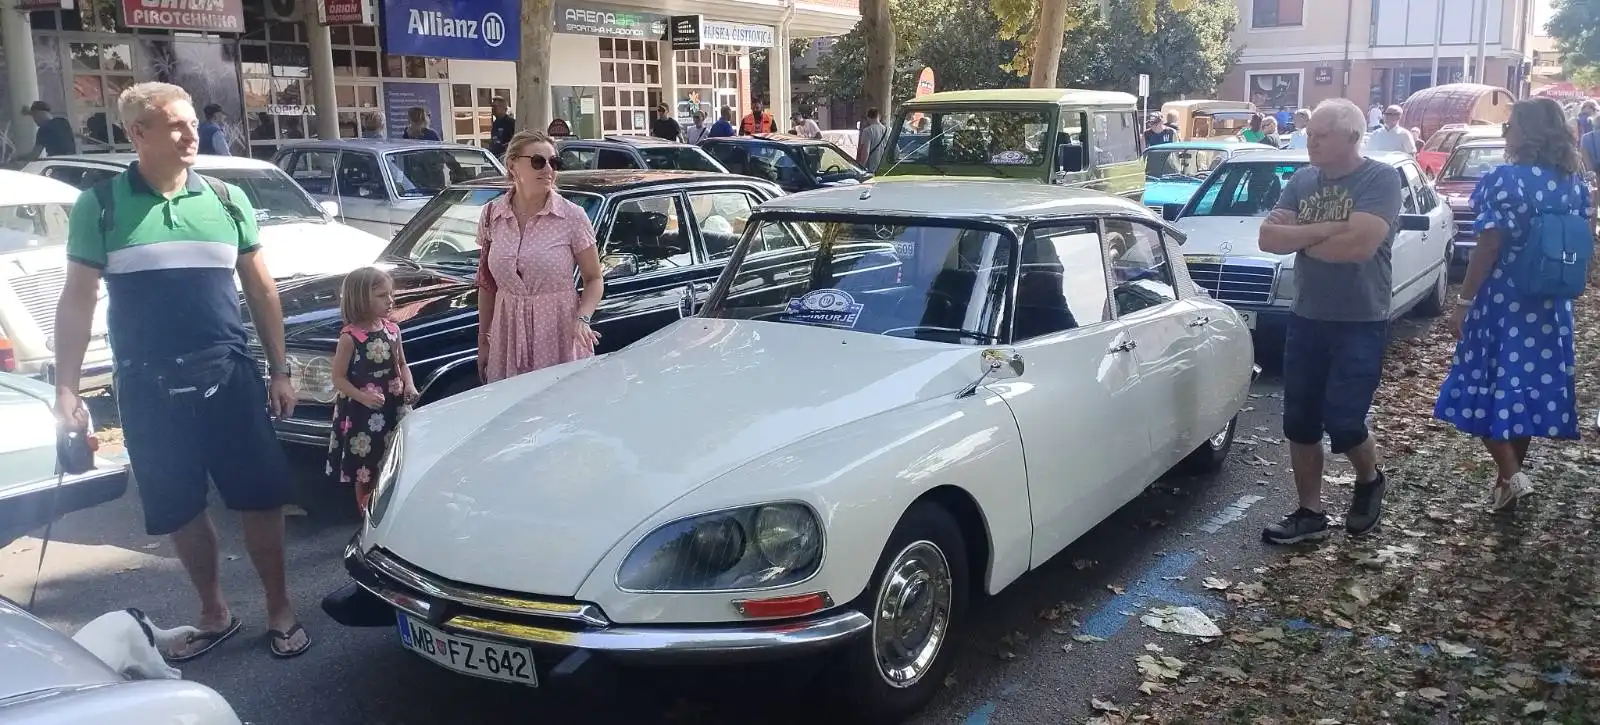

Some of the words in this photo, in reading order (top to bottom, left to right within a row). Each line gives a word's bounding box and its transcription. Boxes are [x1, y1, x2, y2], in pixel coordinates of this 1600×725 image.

[133, 9, 238, 28] PIROTEHNIKA
[329, 4, 358, 14] ORION
[407, 8, 478, 39] Allianz
[410, 622, 436, 655] MB
[447, 638, 531, 679] FZ-642
